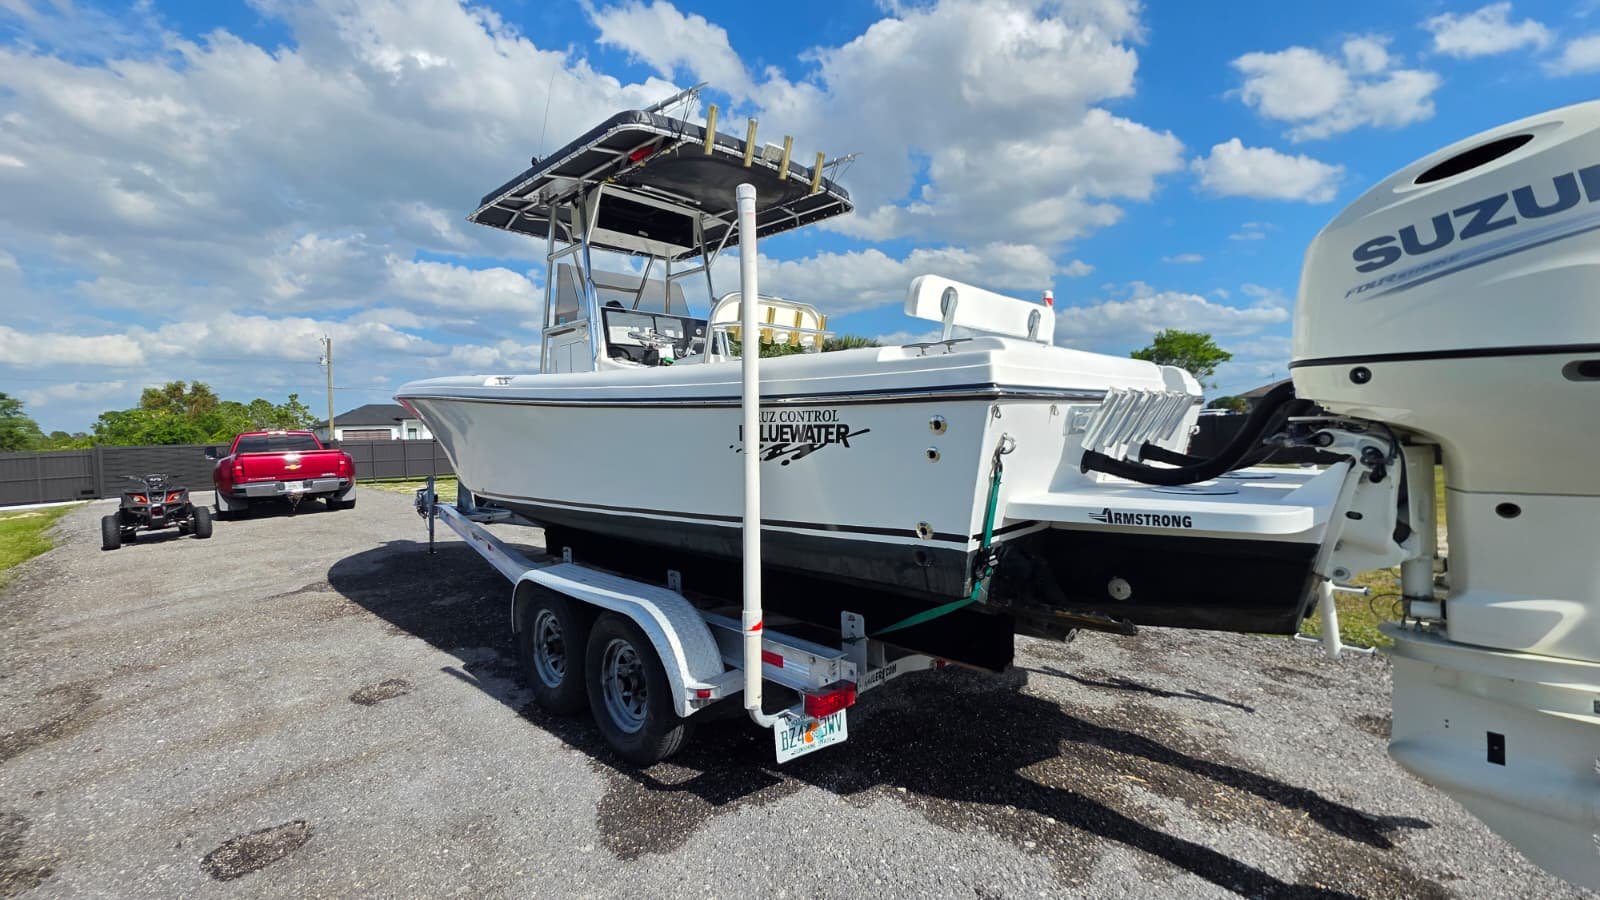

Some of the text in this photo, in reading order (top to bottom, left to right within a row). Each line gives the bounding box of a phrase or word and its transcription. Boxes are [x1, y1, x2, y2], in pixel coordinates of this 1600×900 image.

[759, 409, 840, 423] UZ CONTROL
[738, 423, 850, 448] LUEWATER
[1088, 507, 1192, 528] ARMSTRONG
